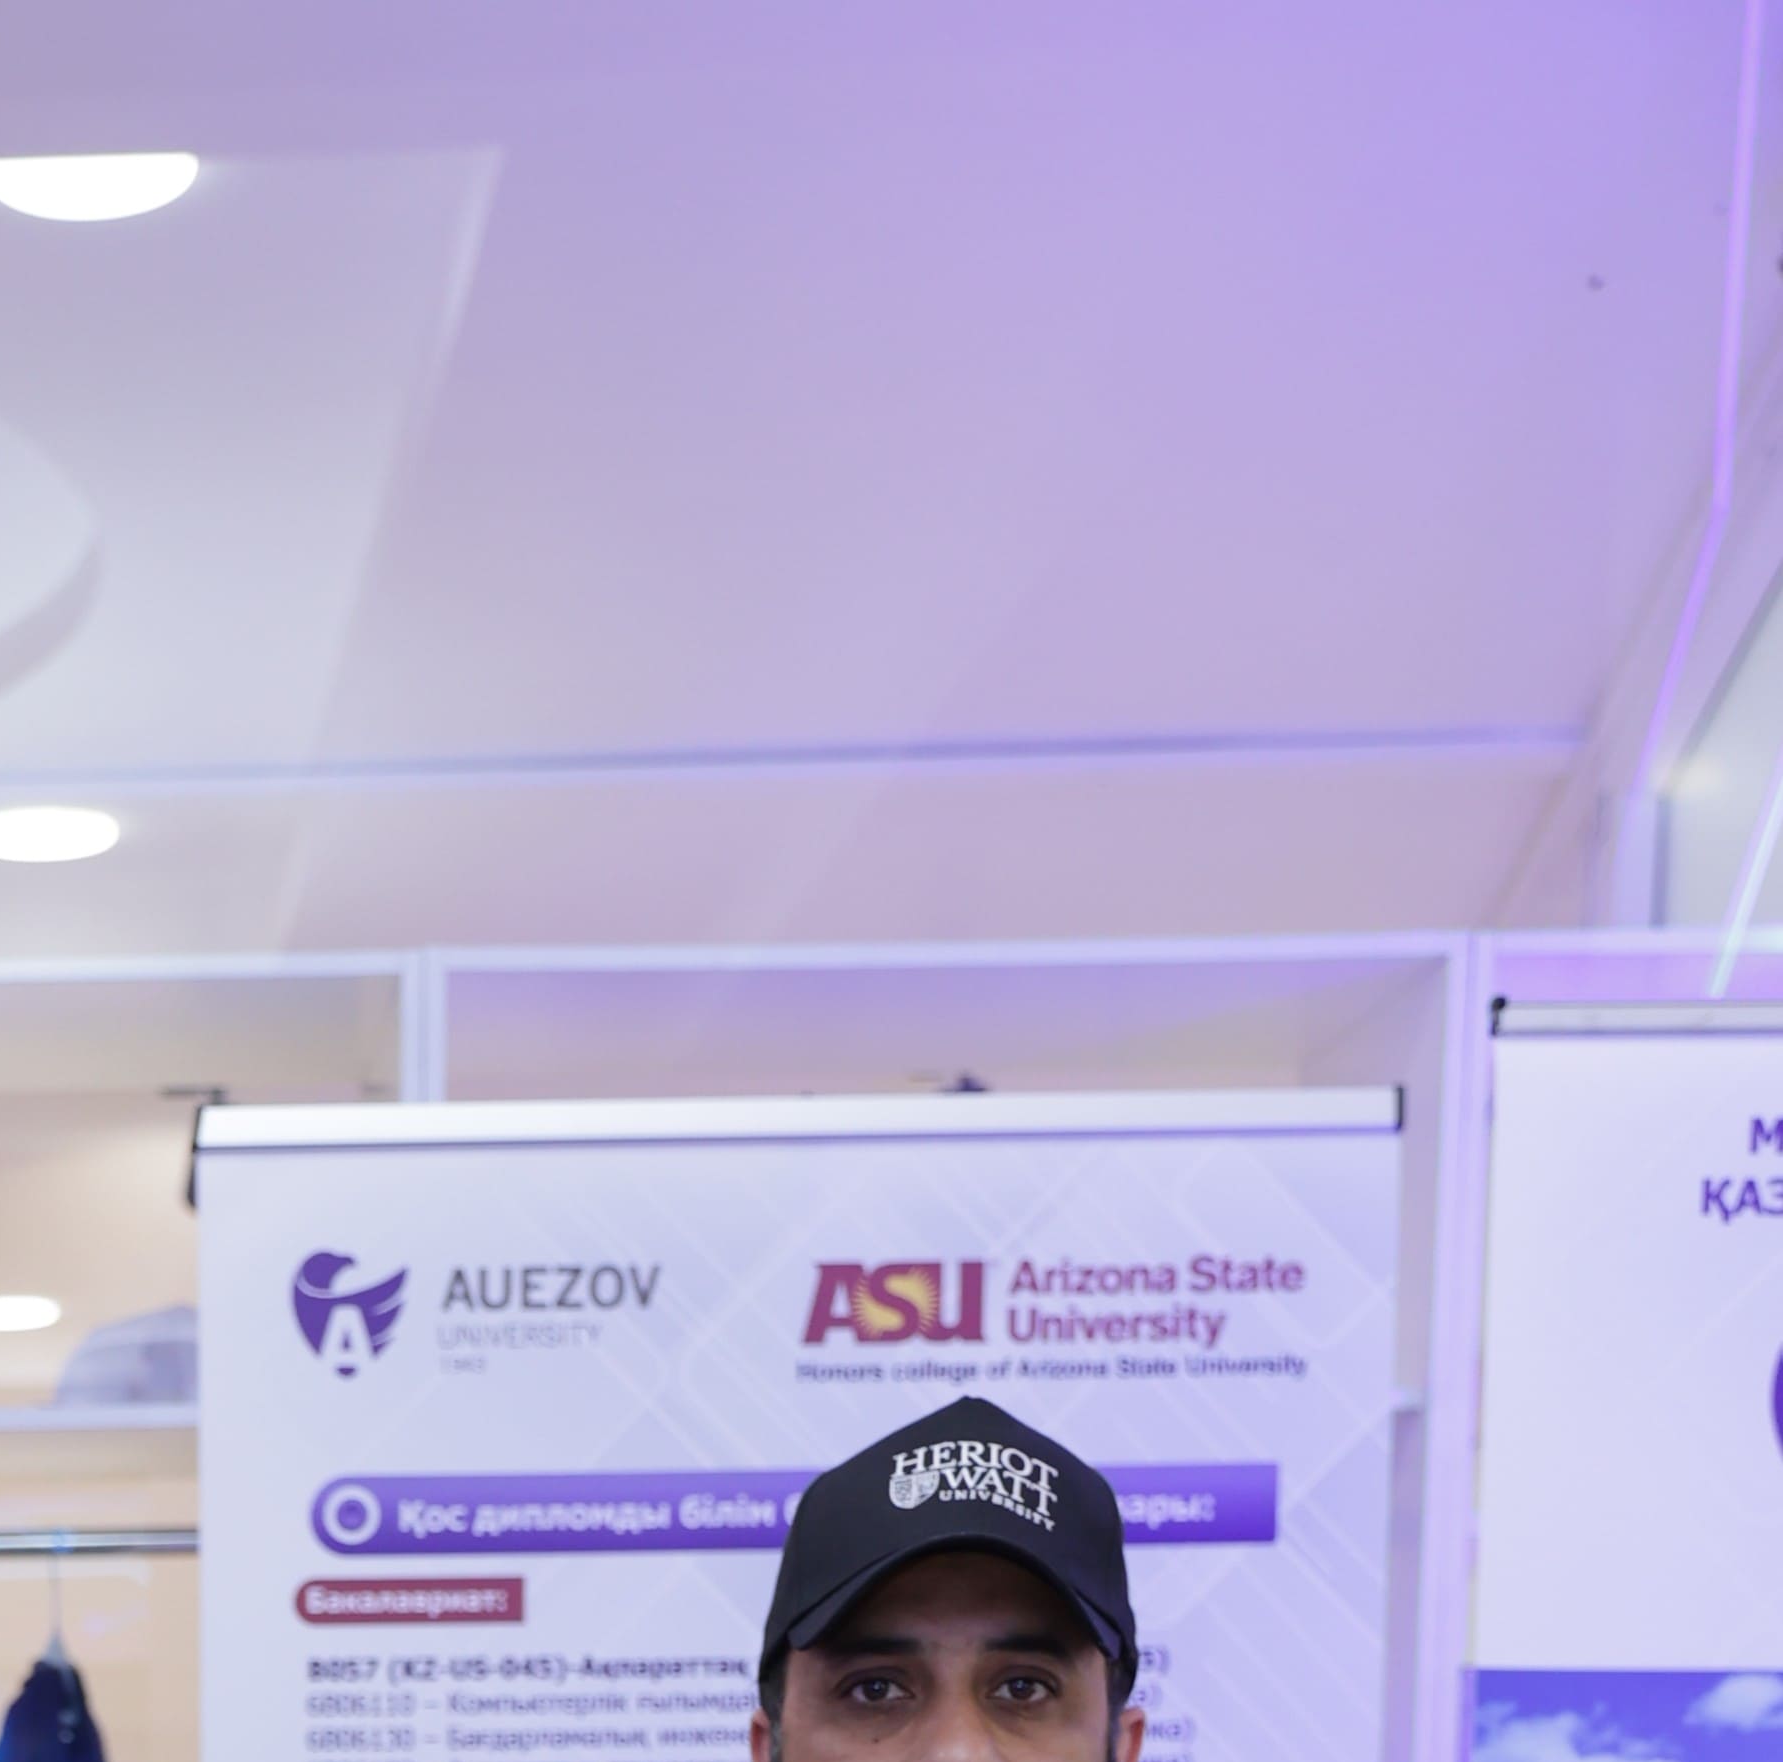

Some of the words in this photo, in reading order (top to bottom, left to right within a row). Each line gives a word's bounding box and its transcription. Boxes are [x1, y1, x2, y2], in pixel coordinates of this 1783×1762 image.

[441, 1263, 661, 1313] AUEZOV
[802, 1260, 985, 1346] ASU
[1008, 1257, 1177, 1297] Arizona
[1187, 1254, 1306, 1293] State
[1006, 1305, 1227, 1350] University
[795, 1361, 883, 1383] Honors
[889, 1360, 979, 1387] college
[985, 1359, 1012, 1380] of
[1016, 1358, 1109, 1382] Arizona
[1116, 1357, 1176, 1379] State
[1184, 1354, 1307, 1381] University
[893, 1440, 1058, 1493] HERIOT
[939, 1465, 1059, 1518] WATT
[938, 1488, 1057, 1534] UNIVERSITY
